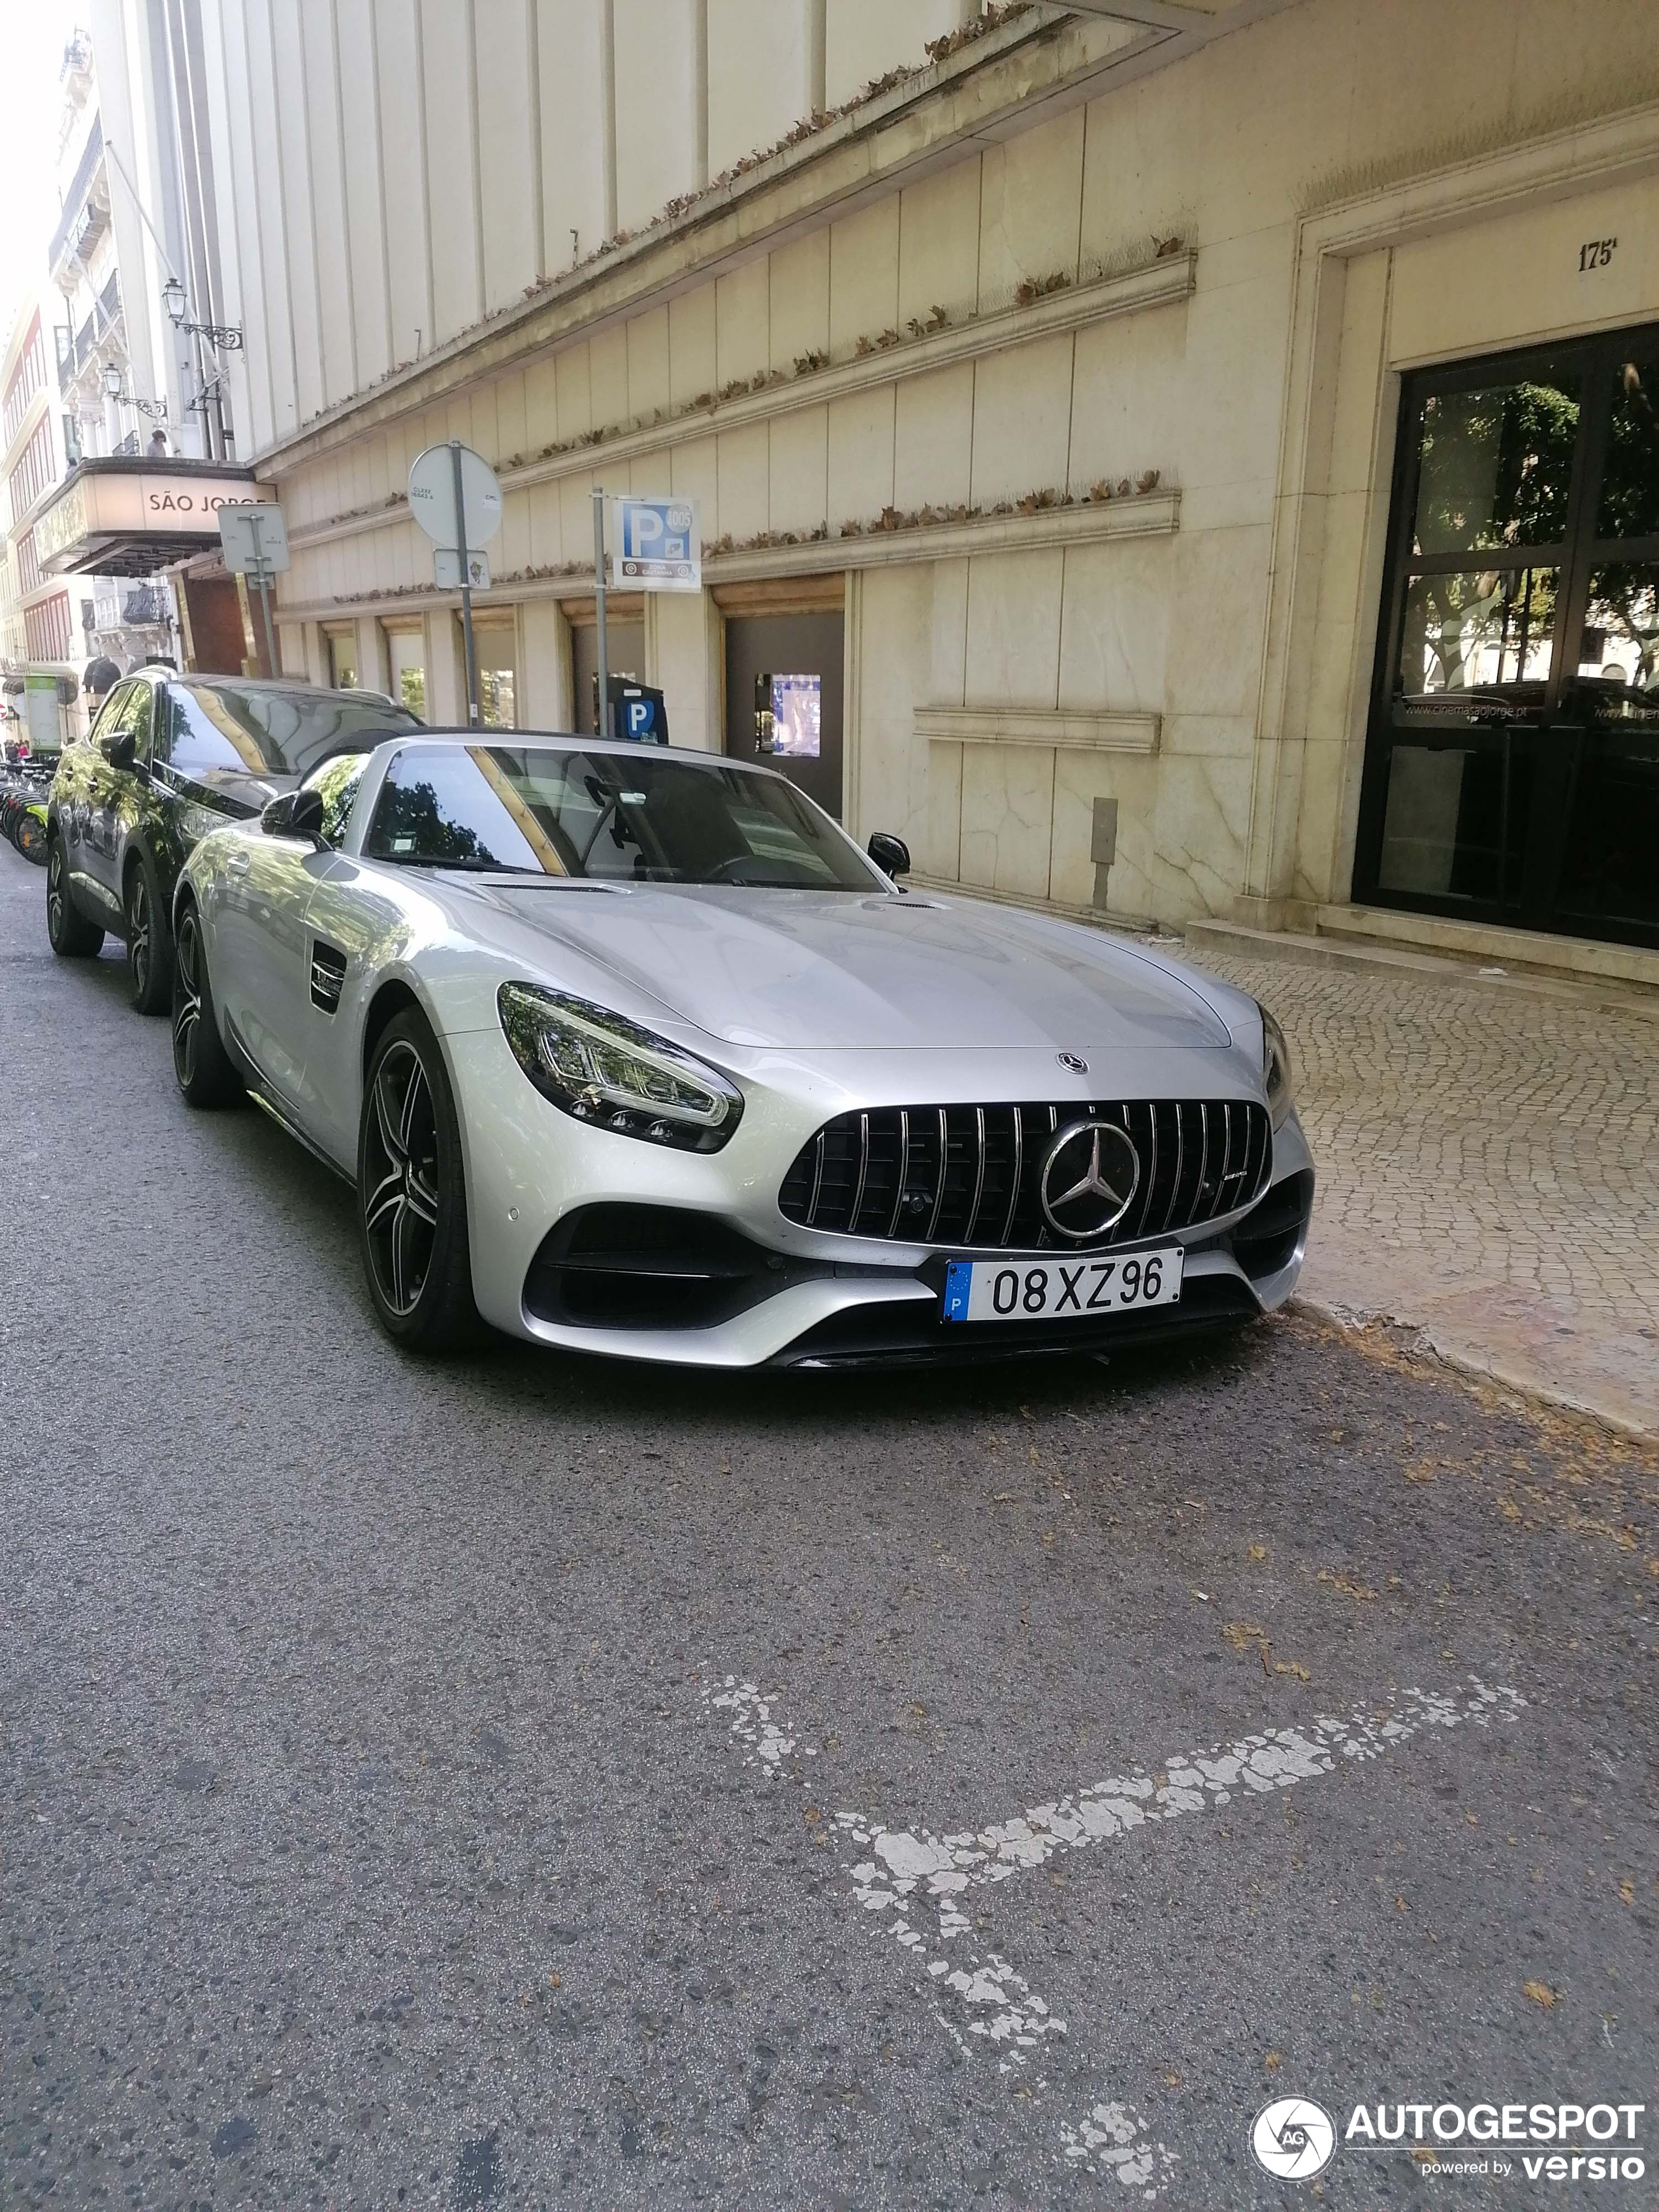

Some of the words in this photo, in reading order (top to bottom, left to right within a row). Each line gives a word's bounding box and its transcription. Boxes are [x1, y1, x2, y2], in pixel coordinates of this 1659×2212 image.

[150, 491, 193, 511] SÃO
[631, 509, 664, 556] P
[631, 704, 647, 731] P
[992, 1257, 1163, 1315] 08XZ96
[951, 1298, 961, 1311] P
